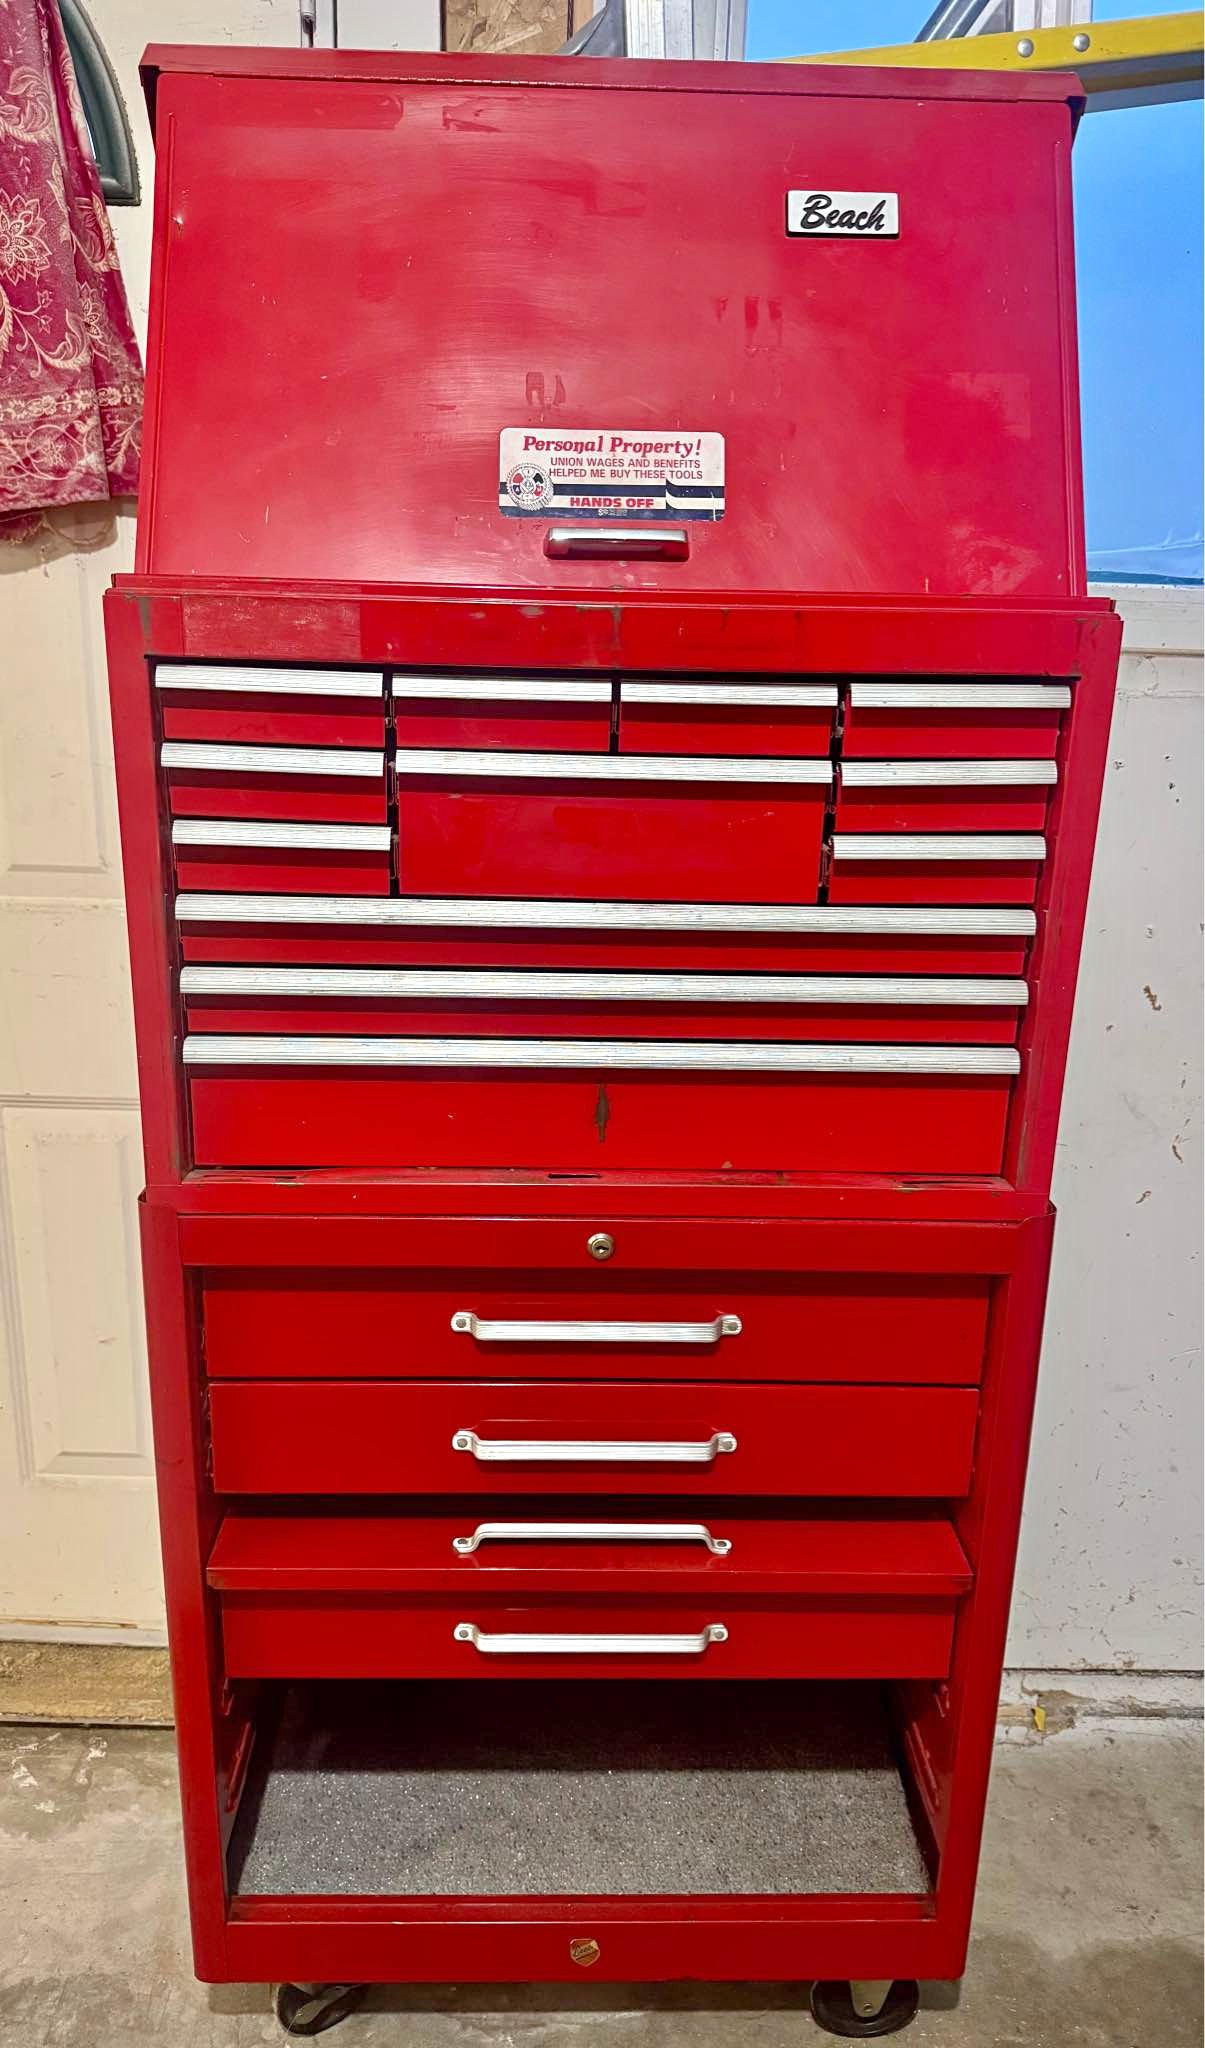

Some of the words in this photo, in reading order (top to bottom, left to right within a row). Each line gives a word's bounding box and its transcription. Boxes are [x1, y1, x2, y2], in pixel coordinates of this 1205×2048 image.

[800, 194, 886, 231] Beach
[522, 435, 604, 454] Personal
[609, 436, 702, 459] Property!
[550, 457, 583, 467] UNION
[586, 457, 625, 468] WAGES
[628, 458, 651, 468] AND
[653, 459, 701, 469] BENEFITS
[549, 468, 587, 478] HELPED
[590, 469, 606, 478] ME
[610, 469, 631, 479] BUY
[633, 469, 666, 479] THESE
[669, 470, 703, 480] TOOLS
[570, 497, 623, 508] HANDS
[625, 497, 655, 509] OFF
